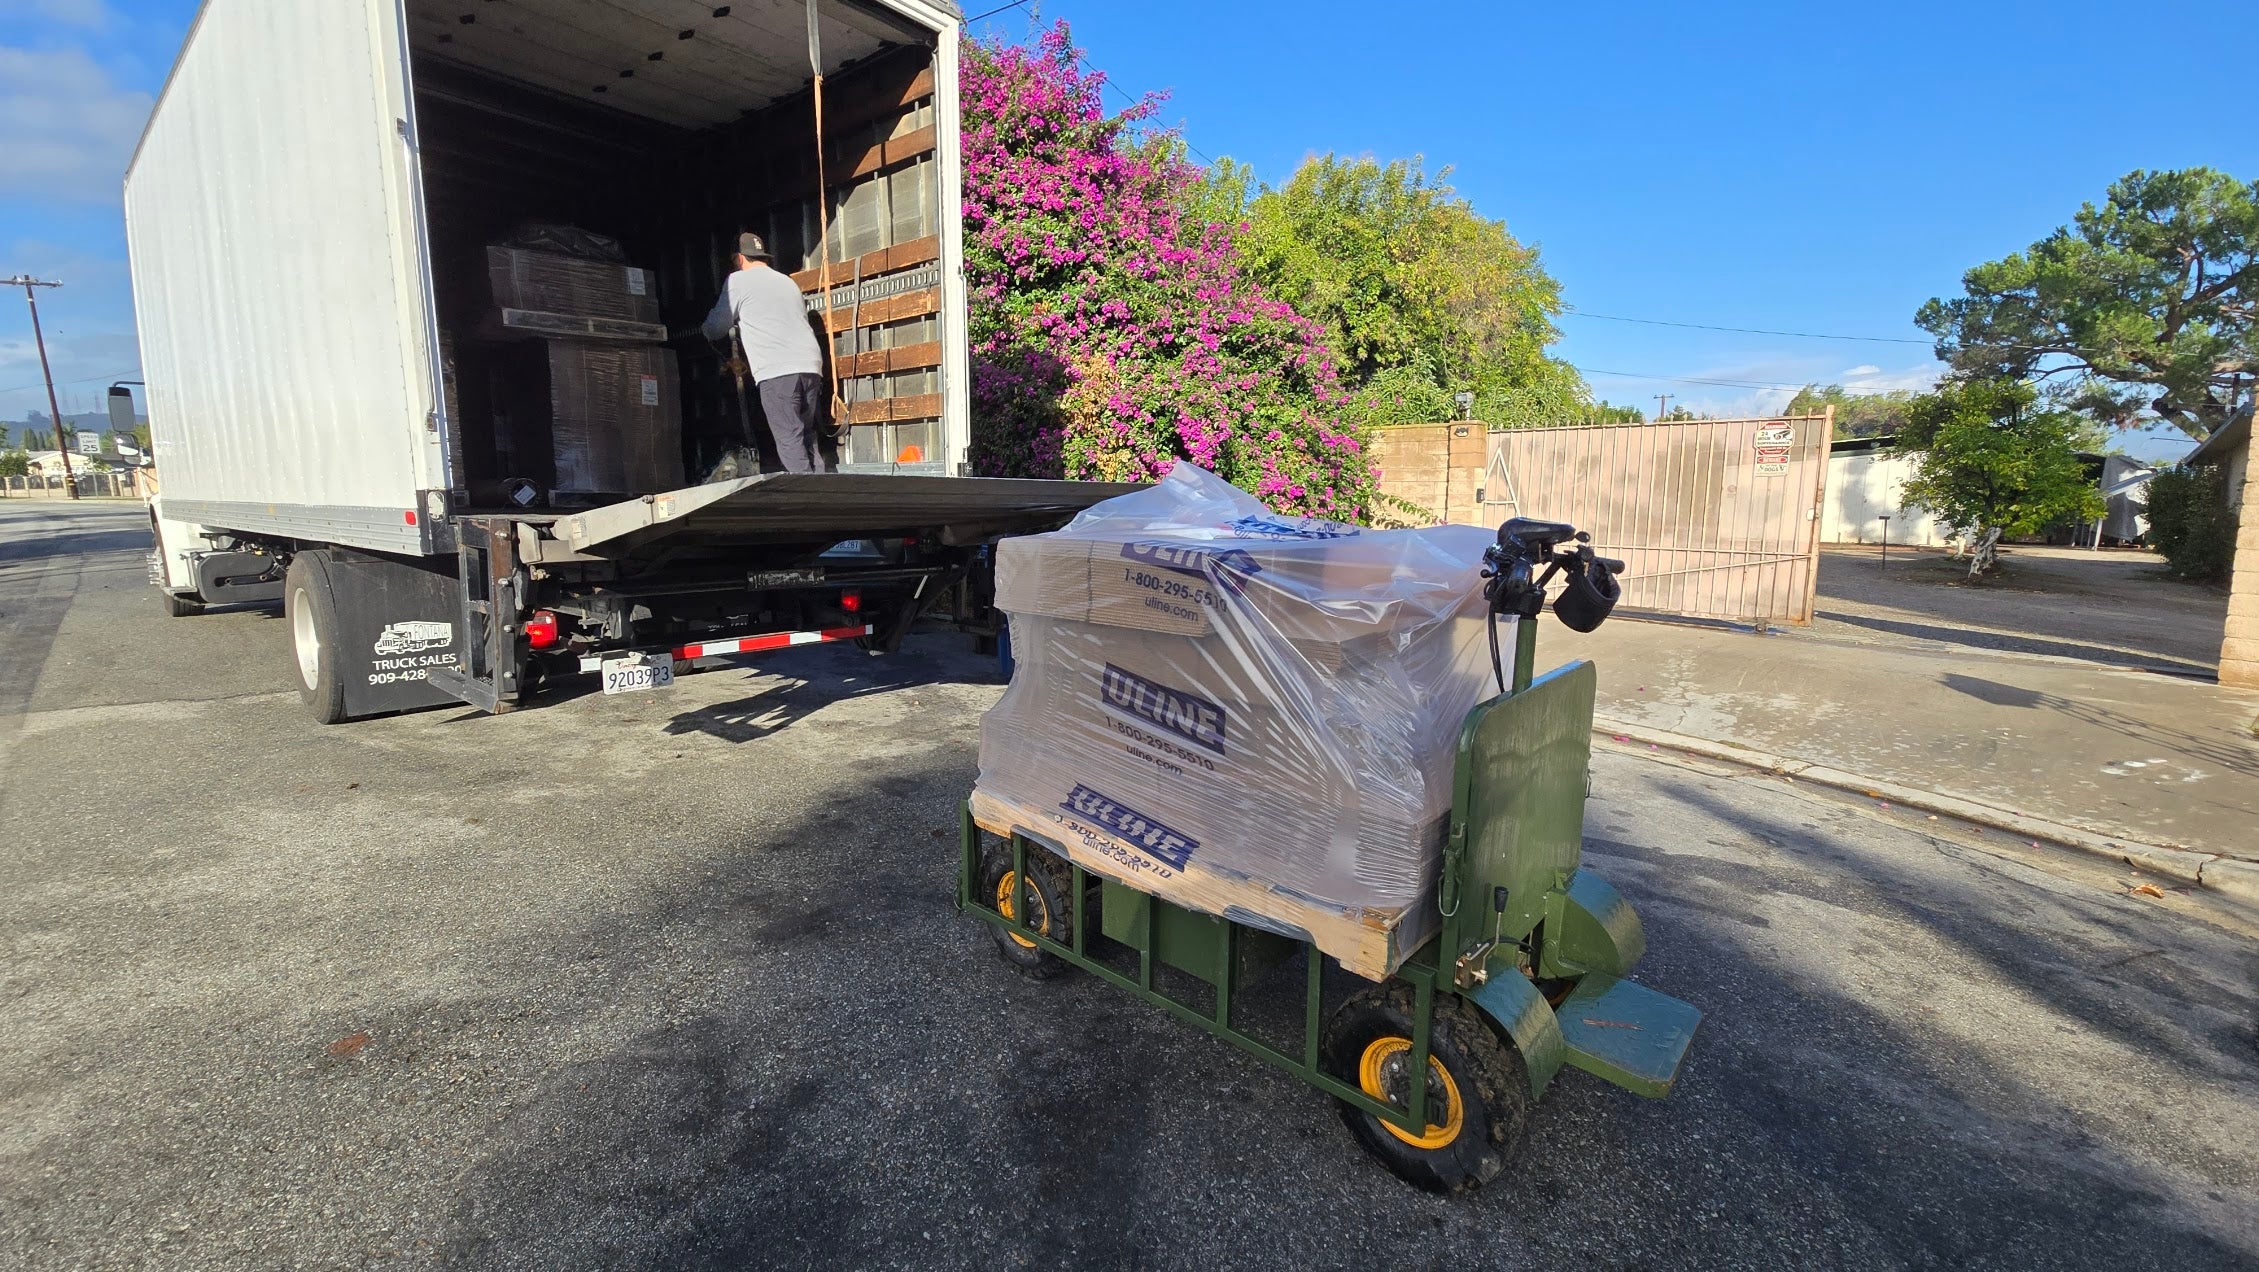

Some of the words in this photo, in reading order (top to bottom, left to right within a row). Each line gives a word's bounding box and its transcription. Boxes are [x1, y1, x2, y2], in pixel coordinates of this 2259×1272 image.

[82, 444, 98, 452] 25
[1124, 568, 1228, 612] 1-800-295-5510
[1144, 597, 1199, 621] uline.com
[414, 624, 449, 639] FONTANA
[372, 657, 418, 671] TRUCK
[420, 653, 457, 666] SALES
[608, 666, 669, 689] 92039P3
[1106, 668, 1219, 748] ULINE
[1105, 716, 1214, 771] 1-800-295-5510
[1126, 744, 1183, 775] uline.com
[1070, 786, 1190, 864] ULINE
[1083, 836, 1140, 873] uline.com
